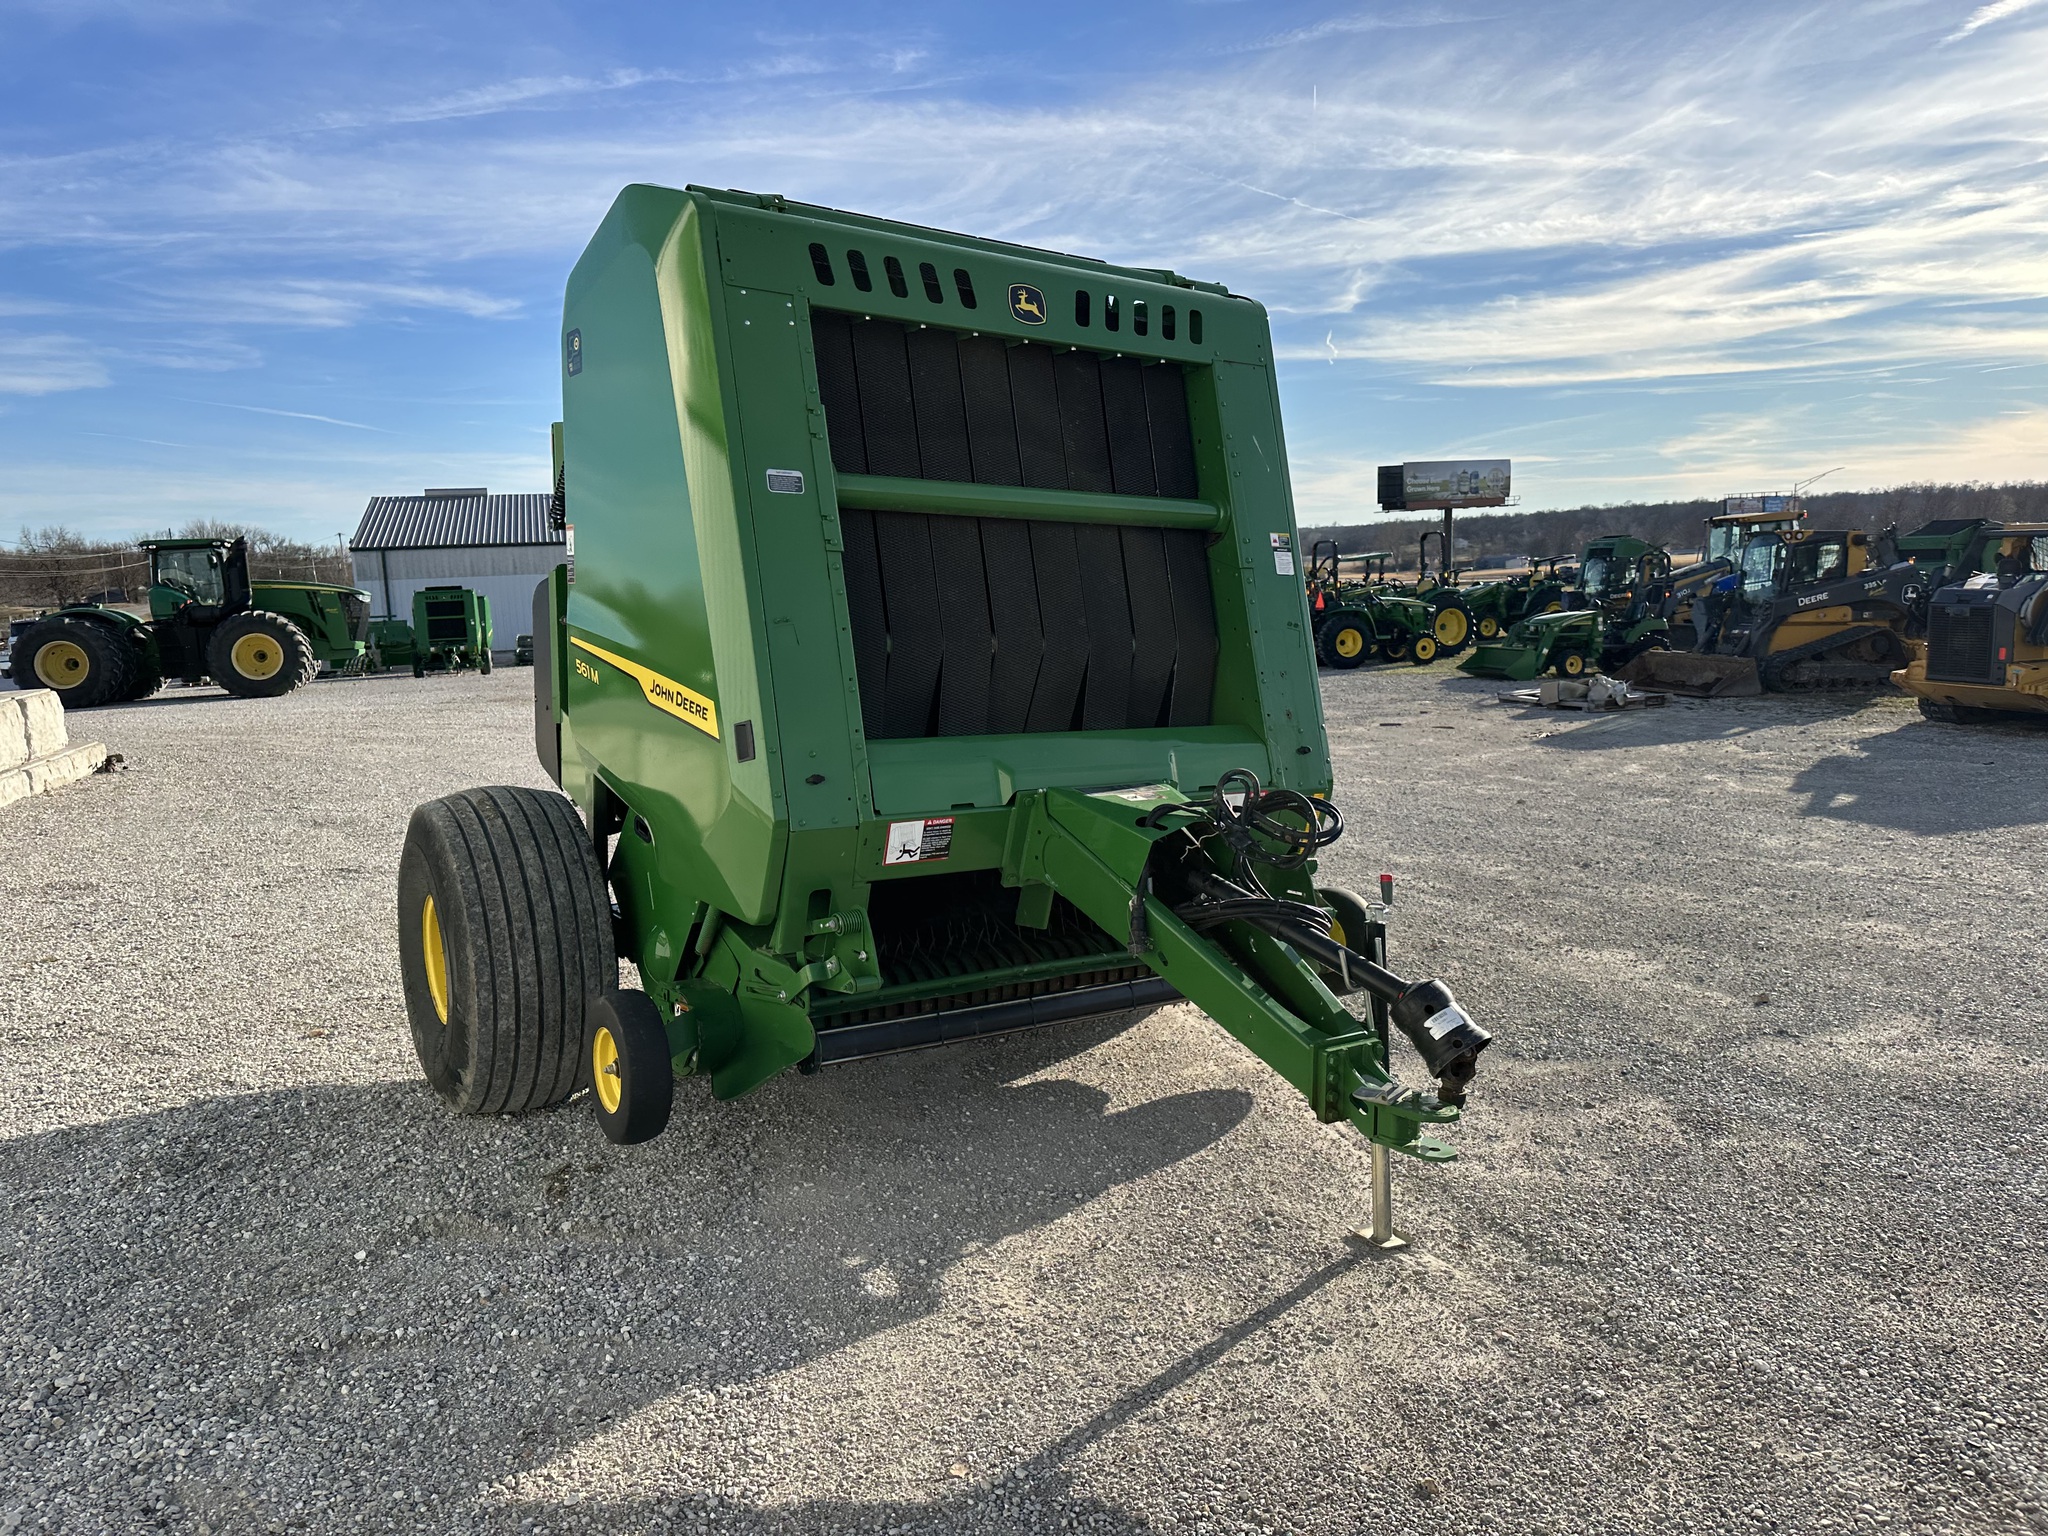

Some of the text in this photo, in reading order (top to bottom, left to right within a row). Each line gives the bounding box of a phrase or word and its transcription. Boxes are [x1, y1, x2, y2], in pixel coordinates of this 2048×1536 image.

[1798, 592, 1829, 607] DEERE
[650, 679, 709, 721] JOHN DEERE
